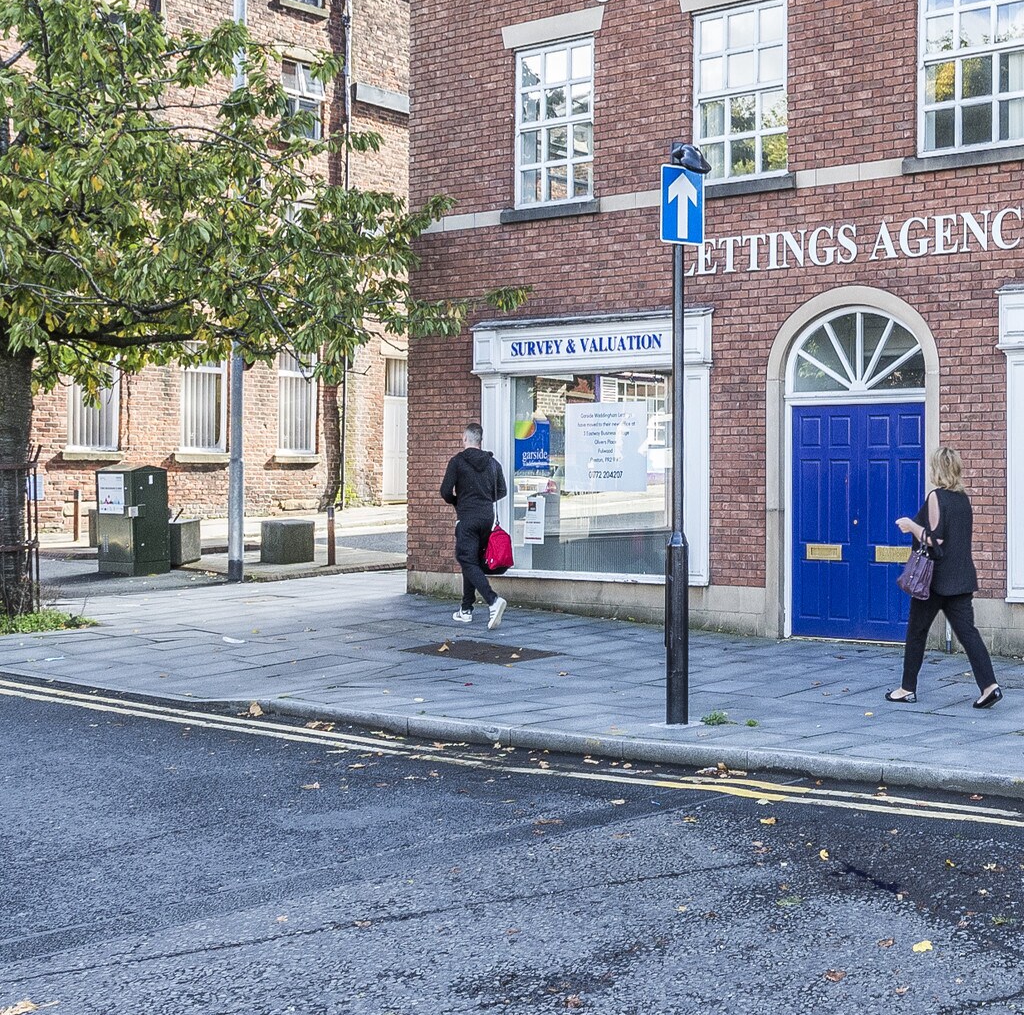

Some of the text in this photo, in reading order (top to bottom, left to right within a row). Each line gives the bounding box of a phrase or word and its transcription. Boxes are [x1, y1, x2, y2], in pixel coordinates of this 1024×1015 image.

[511, 333, 662, 357] SURVEY & VALUATION
[521, 448, 548, 463] garside
